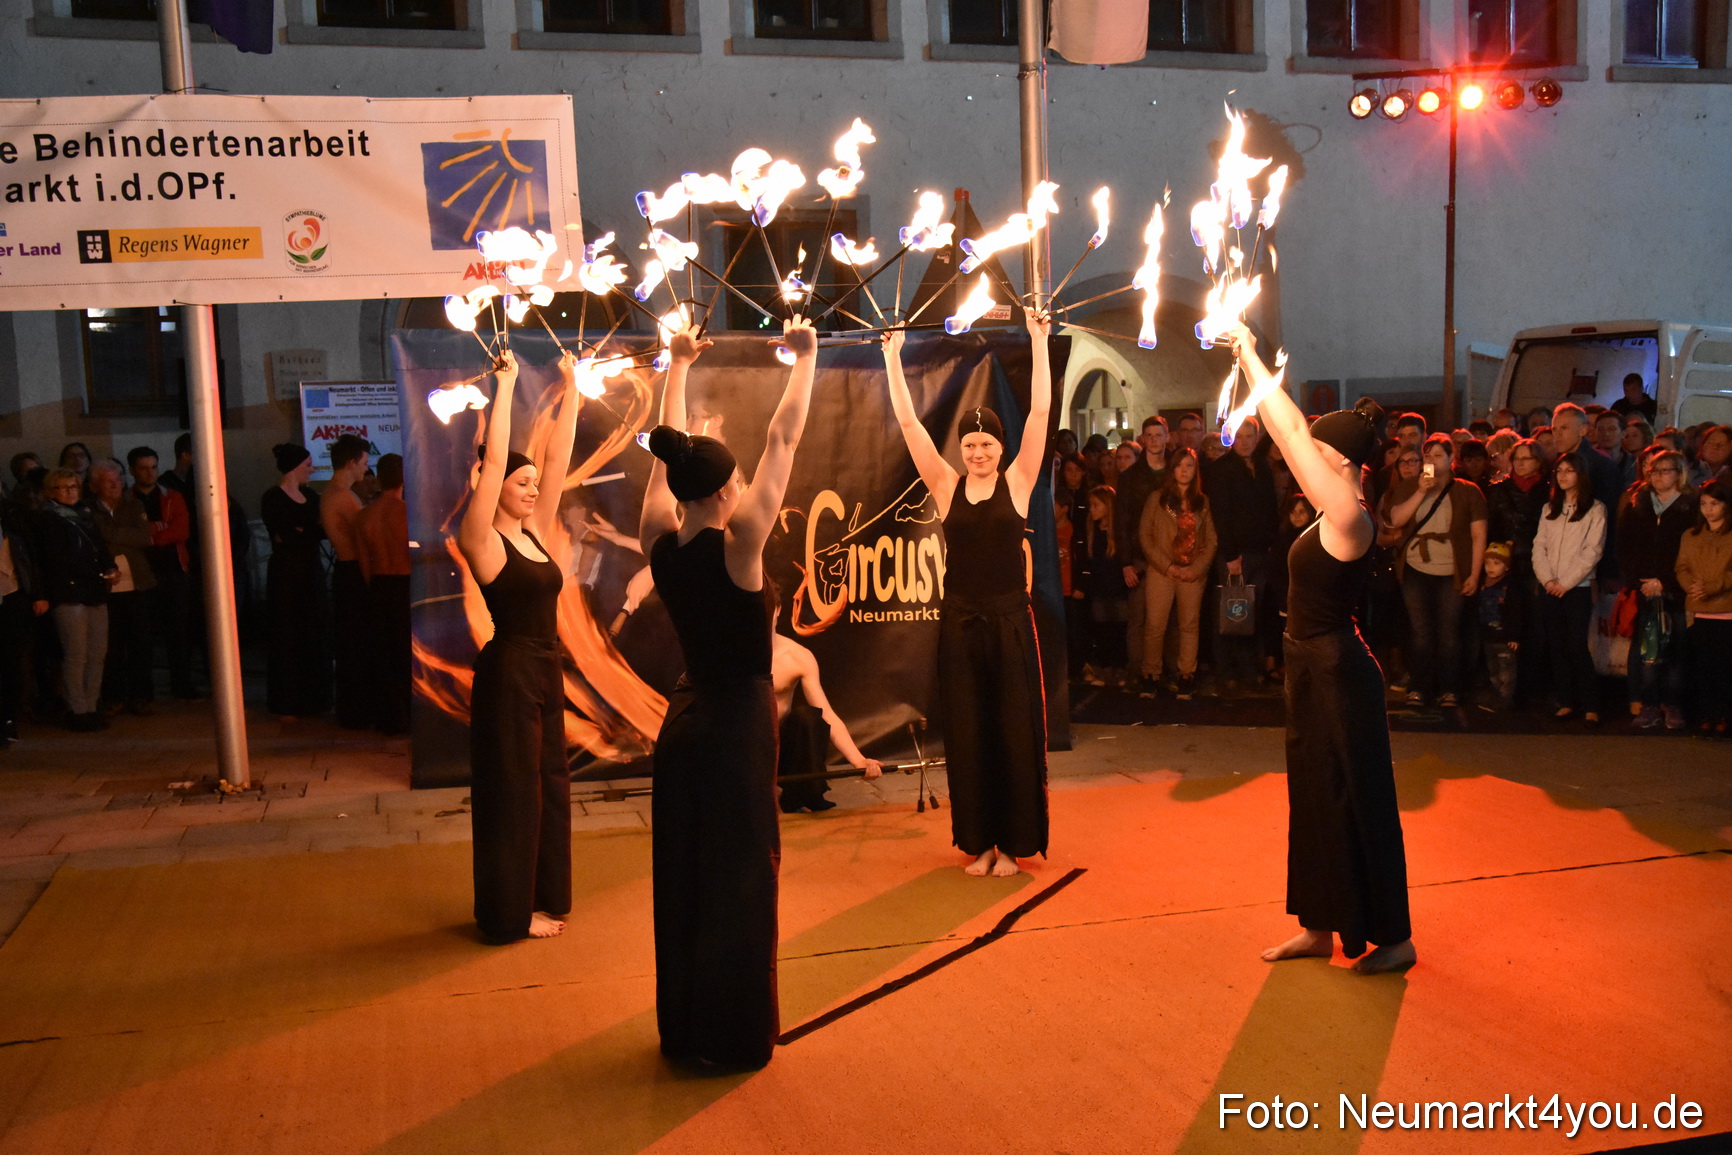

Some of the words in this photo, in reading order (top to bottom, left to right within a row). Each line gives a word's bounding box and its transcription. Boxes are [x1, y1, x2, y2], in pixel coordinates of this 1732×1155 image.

[33, 129, 371, 161] Behindertenarbeit
[95, 171, 236, 202] i.d.OPf.
[19, 243, 61, 257] Land
[119, 236, 178, 258] Regens
[183, 234, 250, 255] Wagner
[850, 606, 940, 623] Neumarkt
